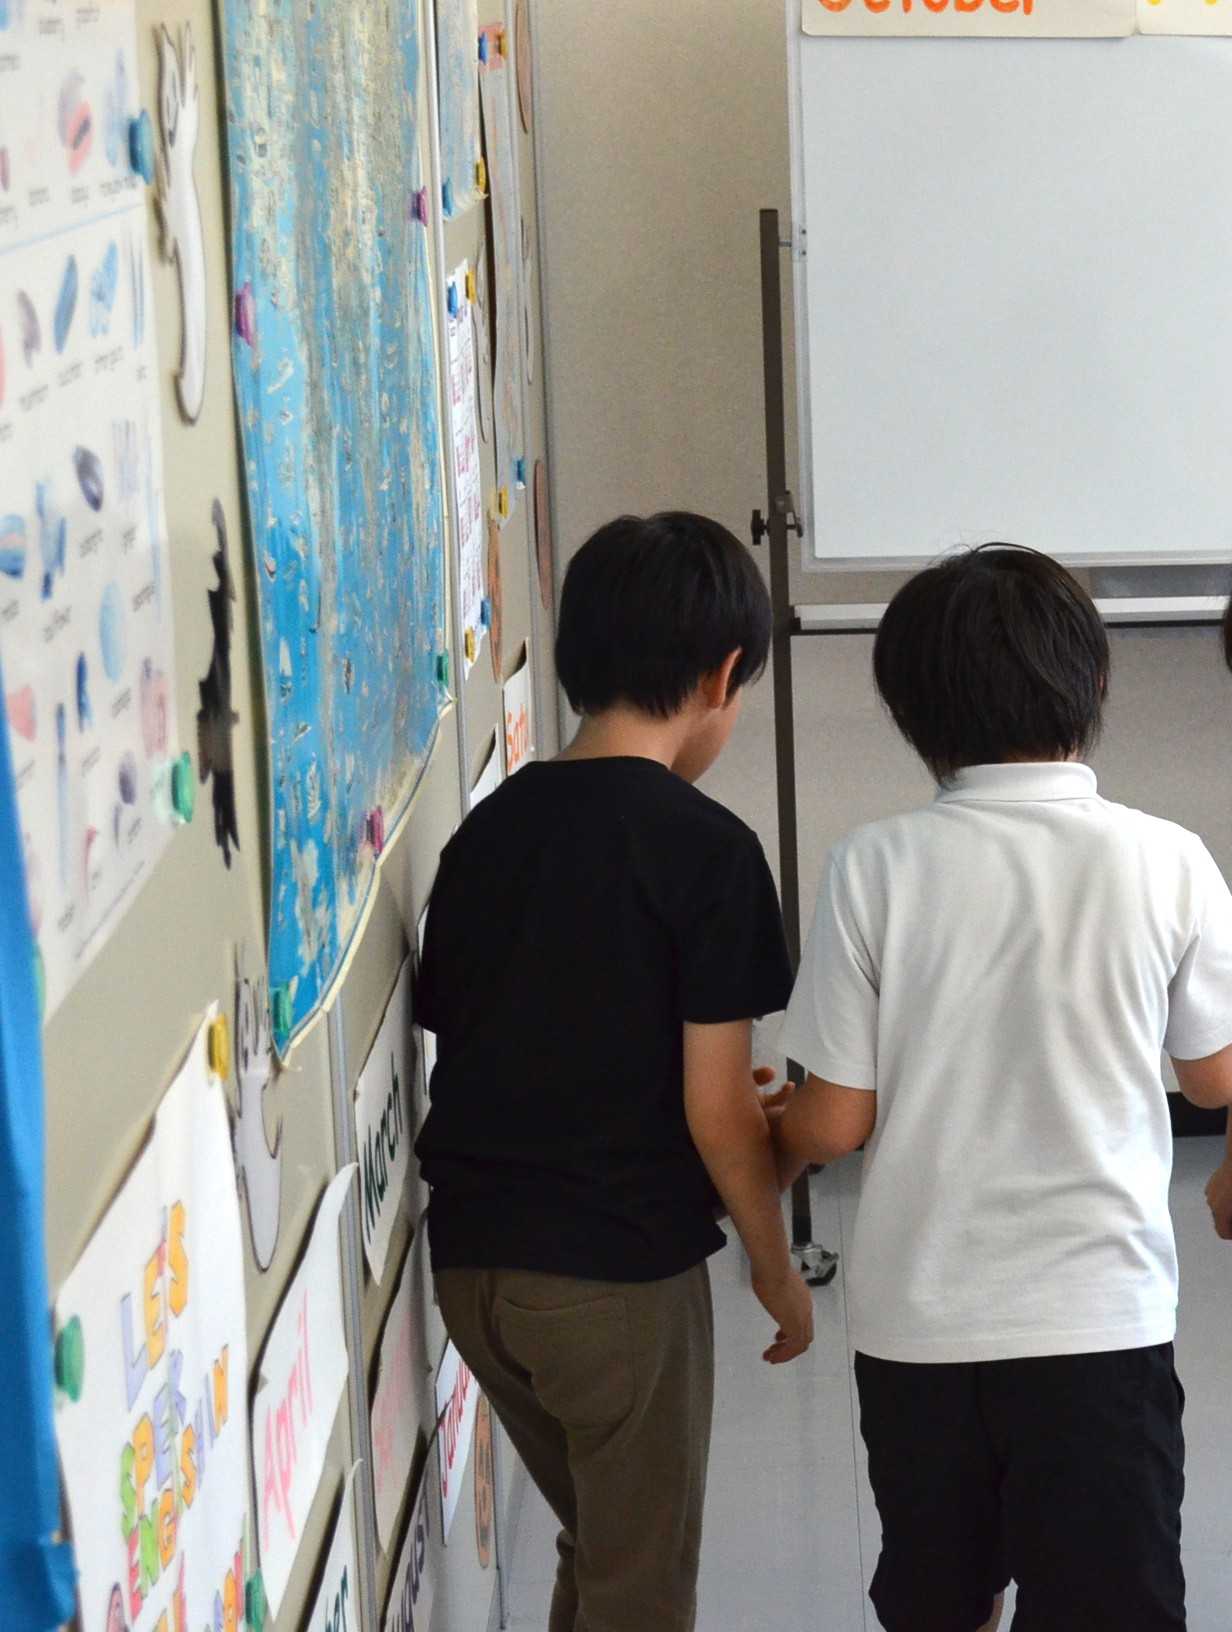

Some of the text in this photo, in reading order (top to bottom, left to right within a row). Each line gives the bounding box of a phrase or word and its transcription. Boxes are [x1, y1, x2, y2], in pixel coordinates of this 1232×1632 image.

[363, 1051, 403, 1245] March
[120, 1348, 187, 1546] SPEK
[127, 1397, 205, 1626] ENGSH
[262, 1288, 315, 1552] April
